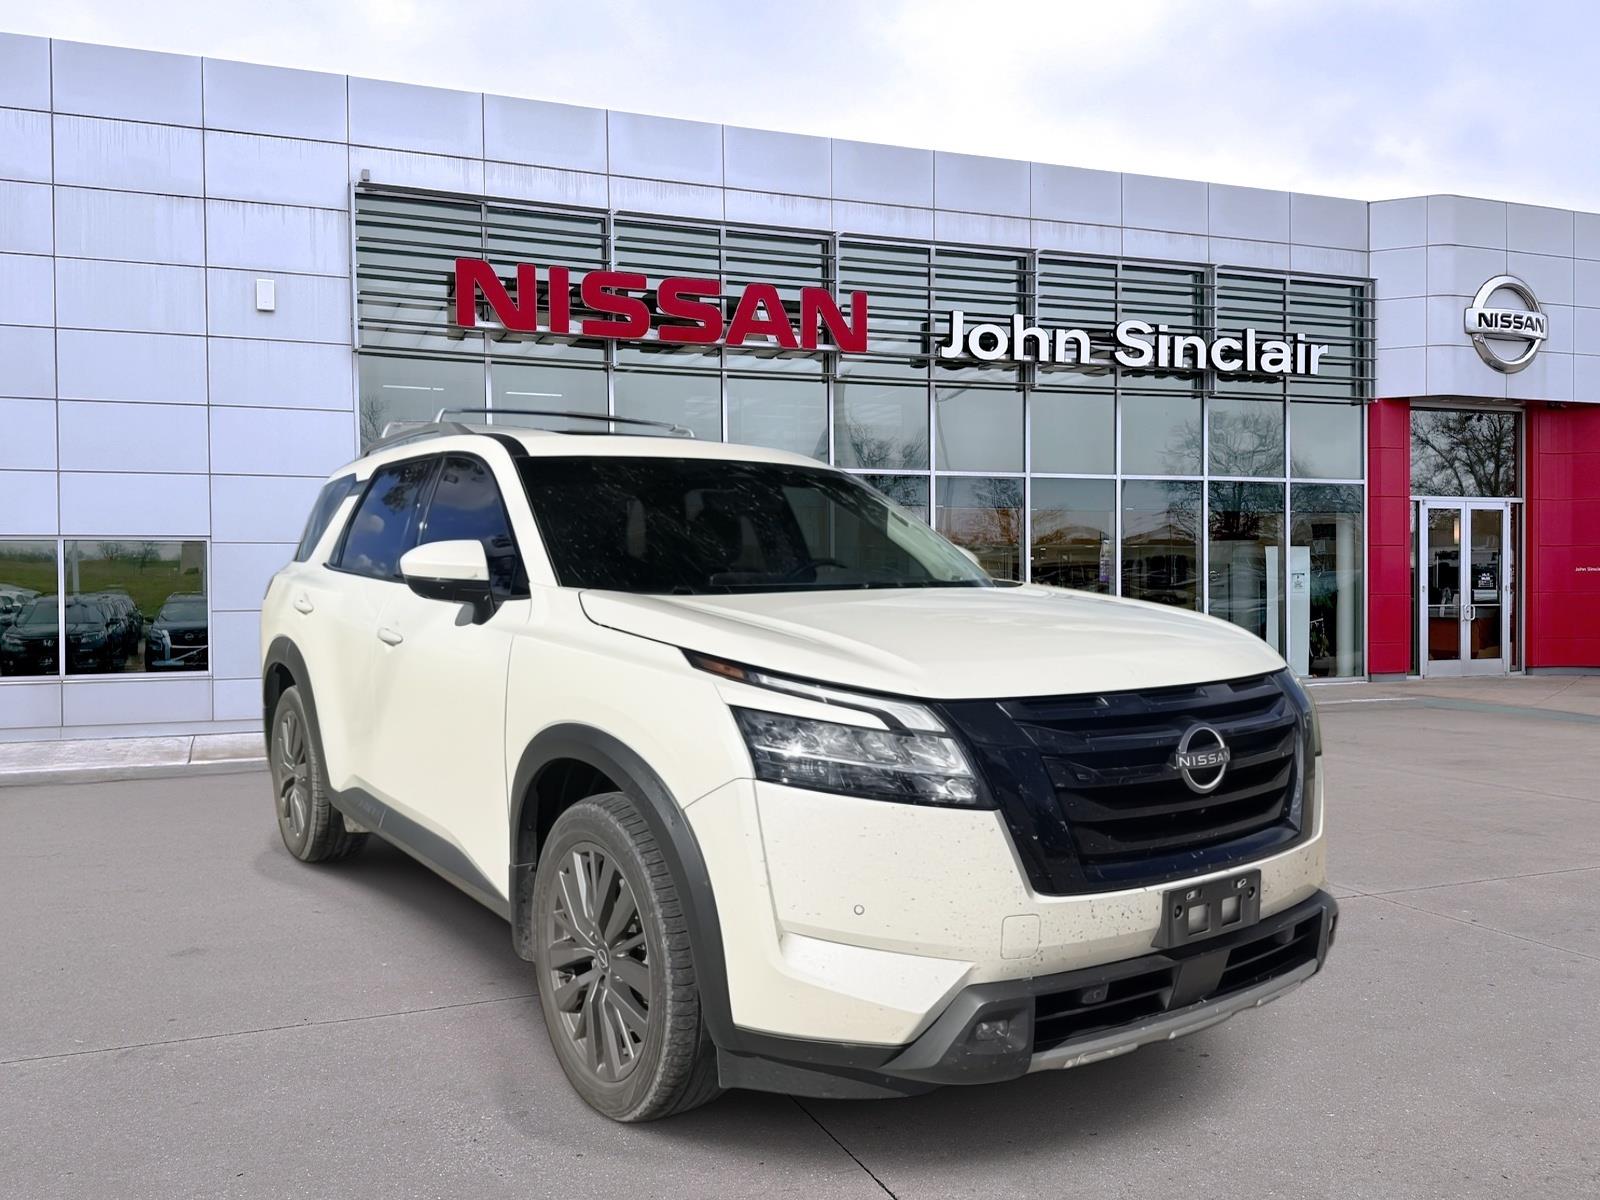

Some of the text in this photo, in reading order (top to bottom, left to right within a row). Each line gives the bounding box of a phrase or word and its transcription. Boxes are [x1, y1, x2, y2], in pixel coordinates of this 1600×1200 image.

[455, 257, 868, 353] NISSAN
[1477, 312, 1545, 334] NISSAN
[940, 309, 1329, 375] John Sinclair
[1178, 751, 1230, 768] NISSAN
